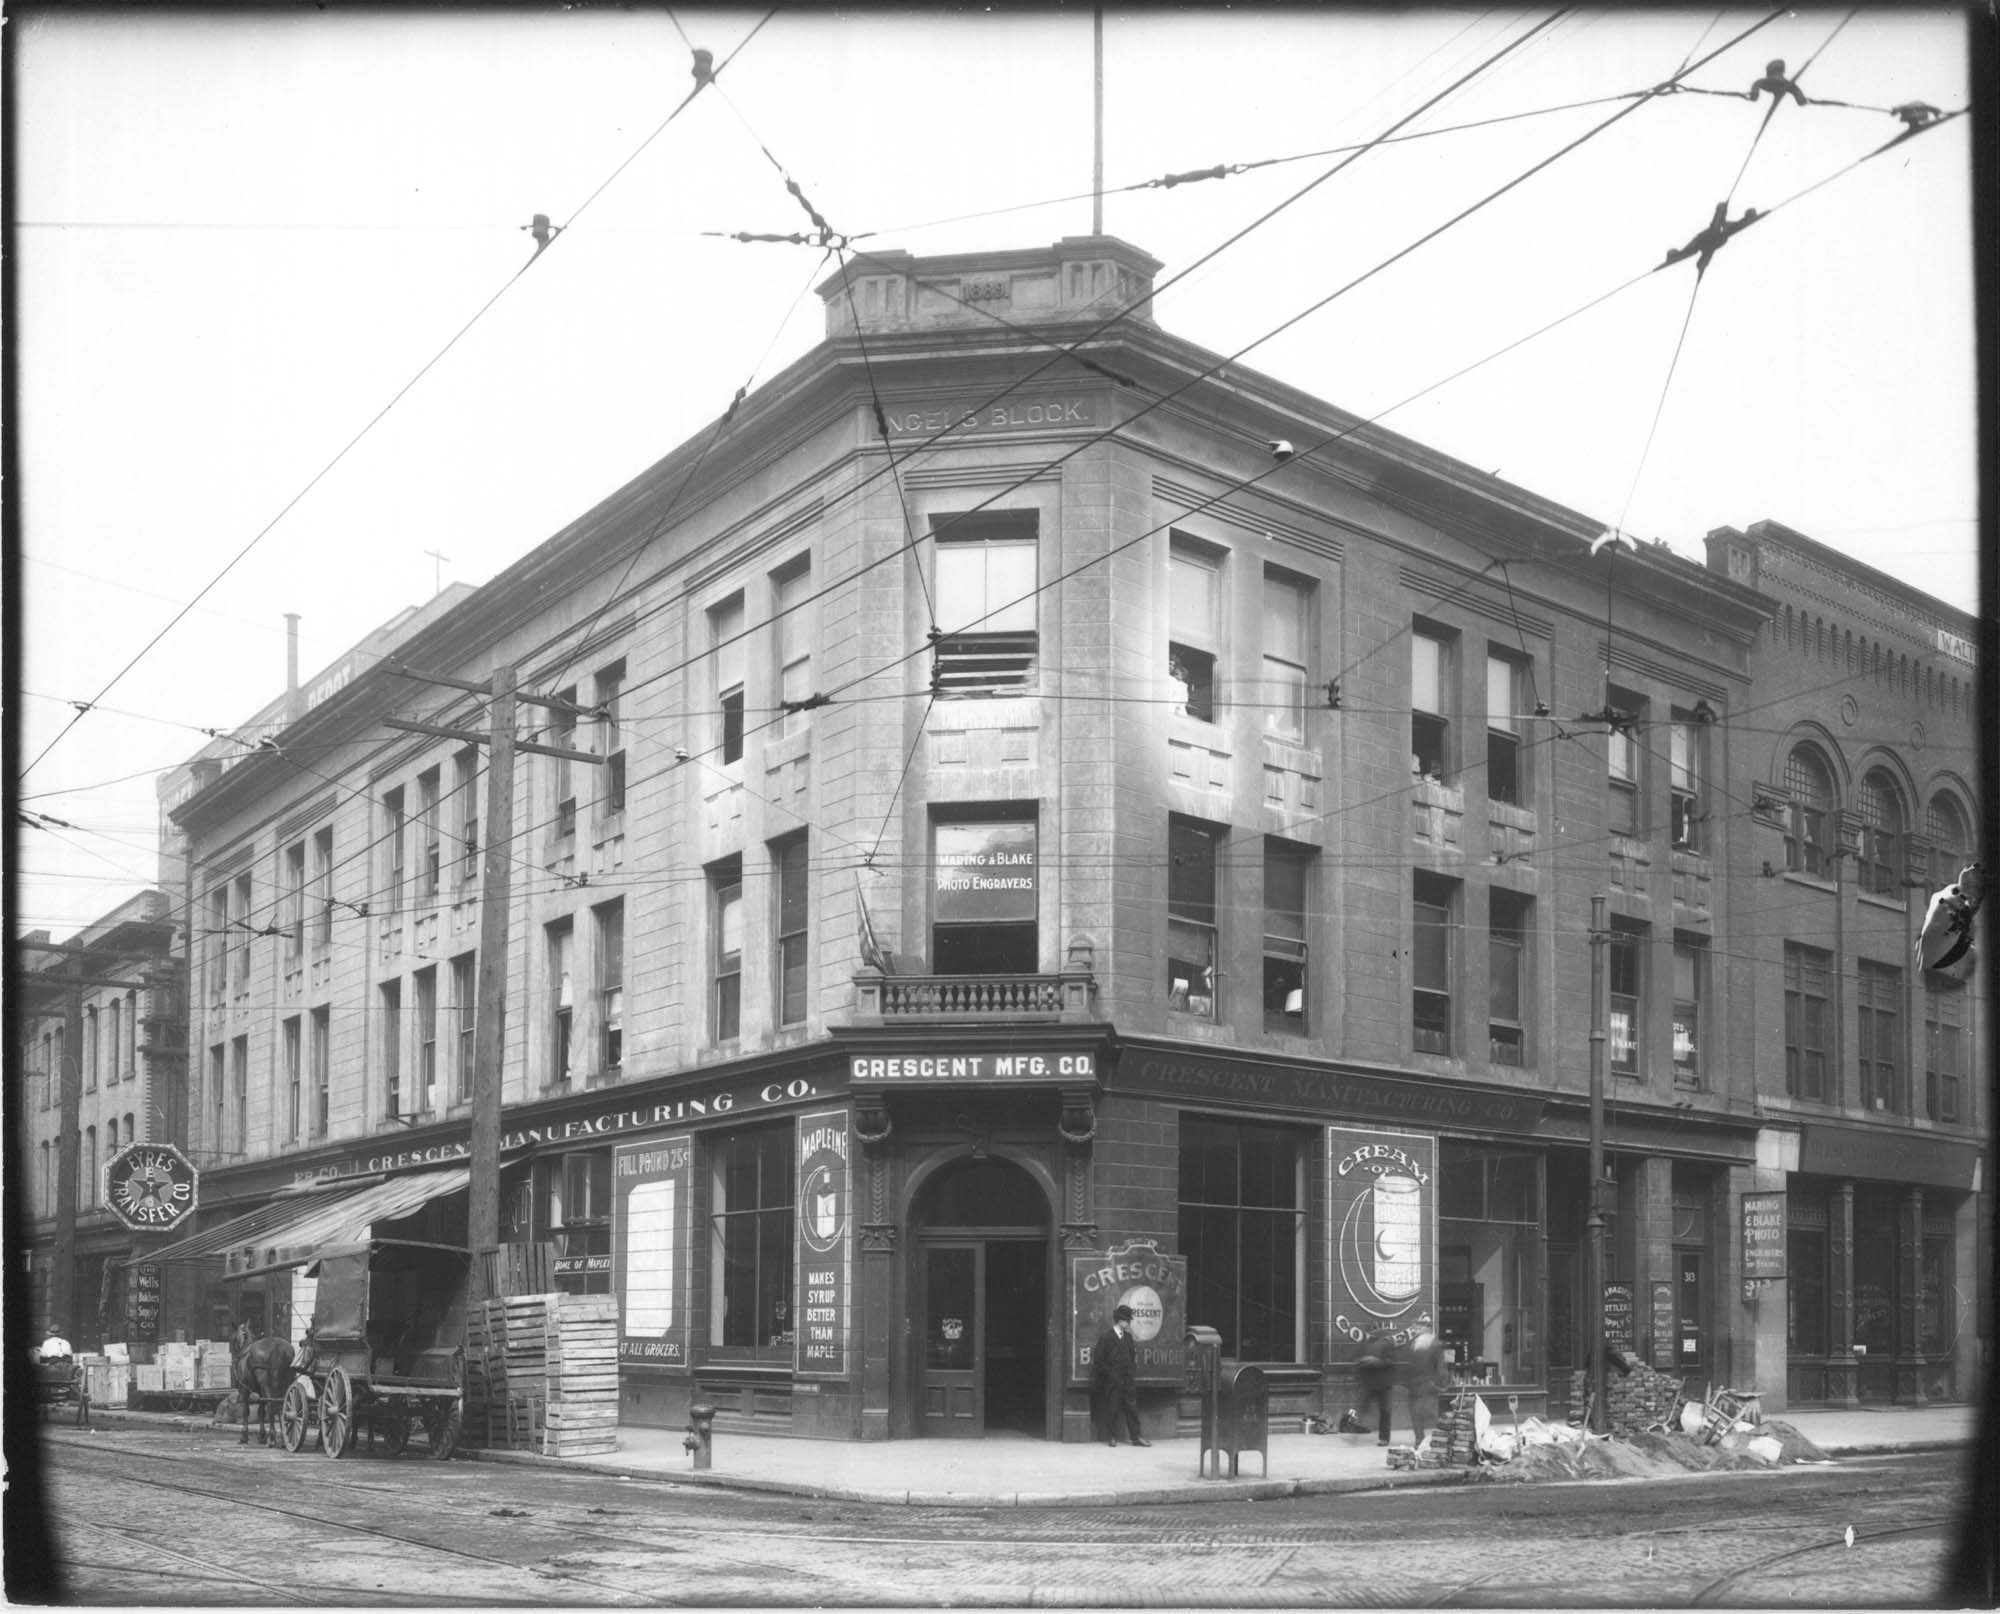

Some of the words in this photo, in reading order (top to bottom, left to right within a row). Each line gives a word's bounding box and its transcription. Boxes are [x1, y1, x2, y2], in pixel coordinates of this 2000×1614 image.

[875, 410, 978, 432] NGELS
[997, 851, 1033, 865] BLAKE
[938, 878, 969, 890] PHOTO
[973, 876, 1033, 890] ENGRAVERS
[853, 1058, 984, 1078] CRESCENT
[995, 1056, 1051, 1076] MFG.
[1059, 1055, 1093, 1074] CO.
[760, 1079, 817, 1103] CO.
[801, 1127, 847, 1167] MAPLEINE
[127, 1151, 177, 1172] EYRES
[618, 1154, 637, 1176] FULL
[638, 1150, 669, 1175] POUND
[1338, 1144, 1429, 1186] CREAM
[113, 1180, 180, 1223] TRANSFER
[1744, 1228, 1780, 1244] PHOTO
[574, 1260, 584, 1270] OF
[808, 1271, 836, 1285] MAKES
[807, 1289, 836, 1304] SYRUP
[806, 1308, 836, 1322] BETTER
[1132, 1308, 1161, 1318] RESCENT
[809, 1326, 834, 1341] THAN
[617, 1343, 627, 1355] AT
[629, 1343, 643, 1356] ALL
[806, 1345, 836, 1360] MAPLE
